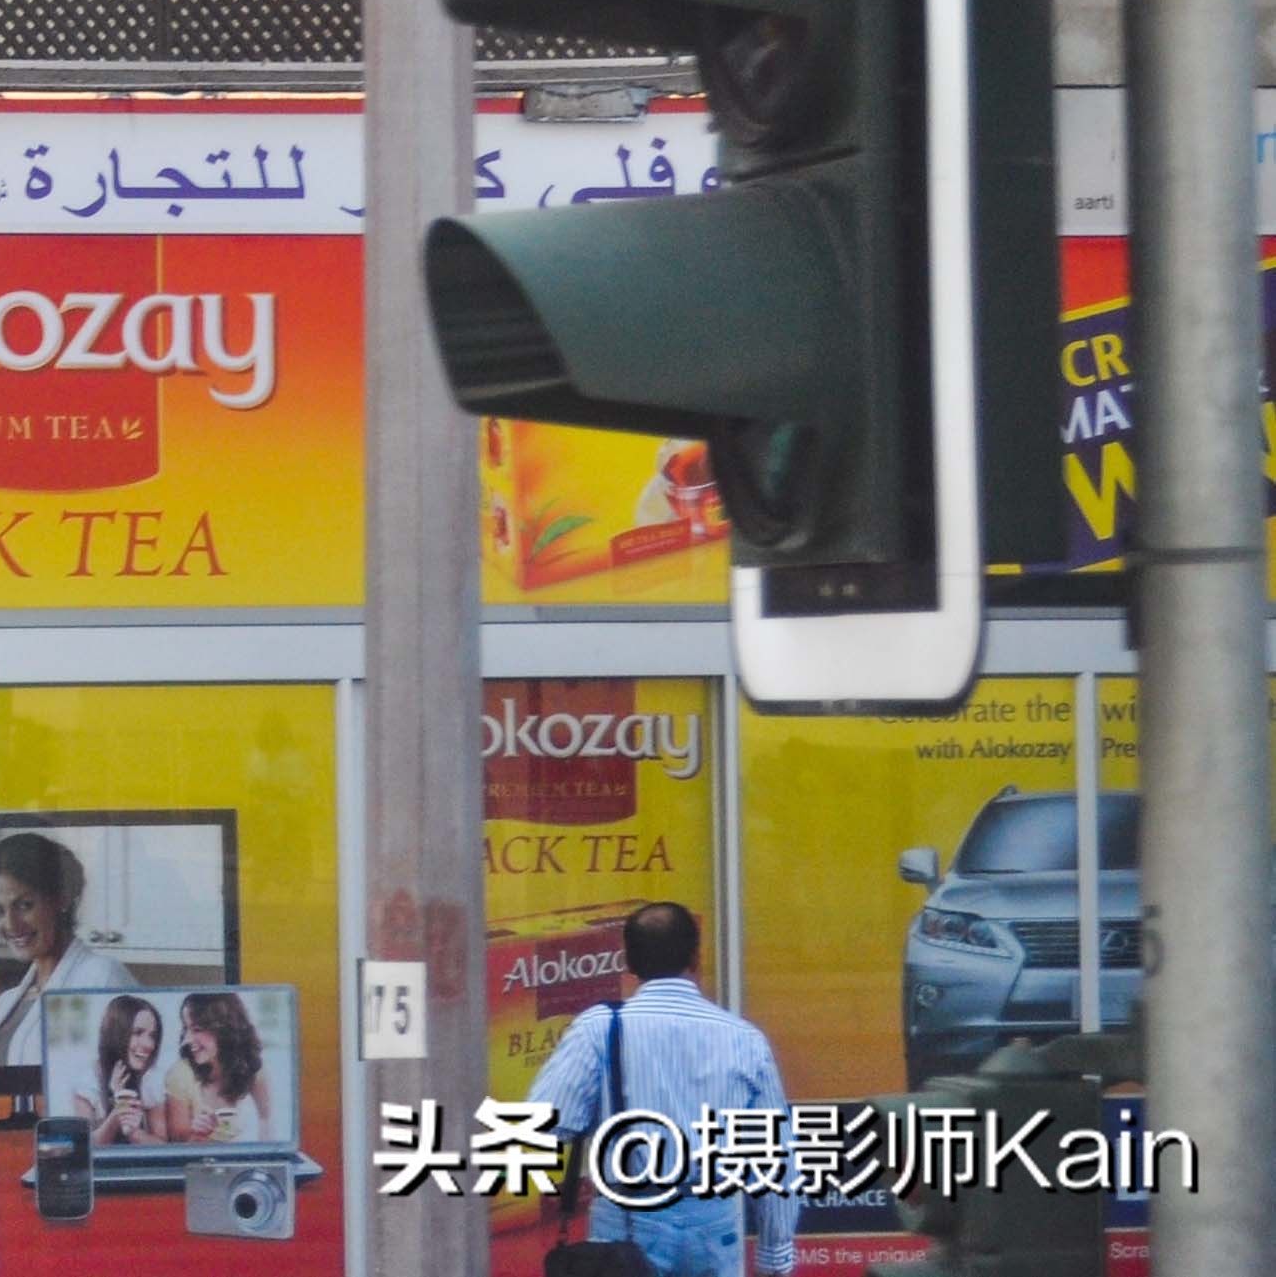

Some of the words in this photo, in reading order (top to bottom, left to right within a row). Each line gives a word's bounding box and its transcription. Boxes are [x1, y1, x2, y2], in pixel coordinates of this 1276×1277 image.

[24, 144, 306, 218] للتجارة
[44, 415, 116, 440] TEA
[61, 510, 227, 578] TEA
[1026, 693, 1072, 723] the
[481, 698, 703, 780] okozay
[916, 738, 964, 760] with
[971, 738, 1072, 761] Alokozay
[581, 835, 675, 873] TEA
[503, 949, 627, 994] Alokoza
[508, 1026, 563, 1057] BLA
[835, 1247, 863, 1264] the
[1110, 1241, 1150, 1260] Scra
